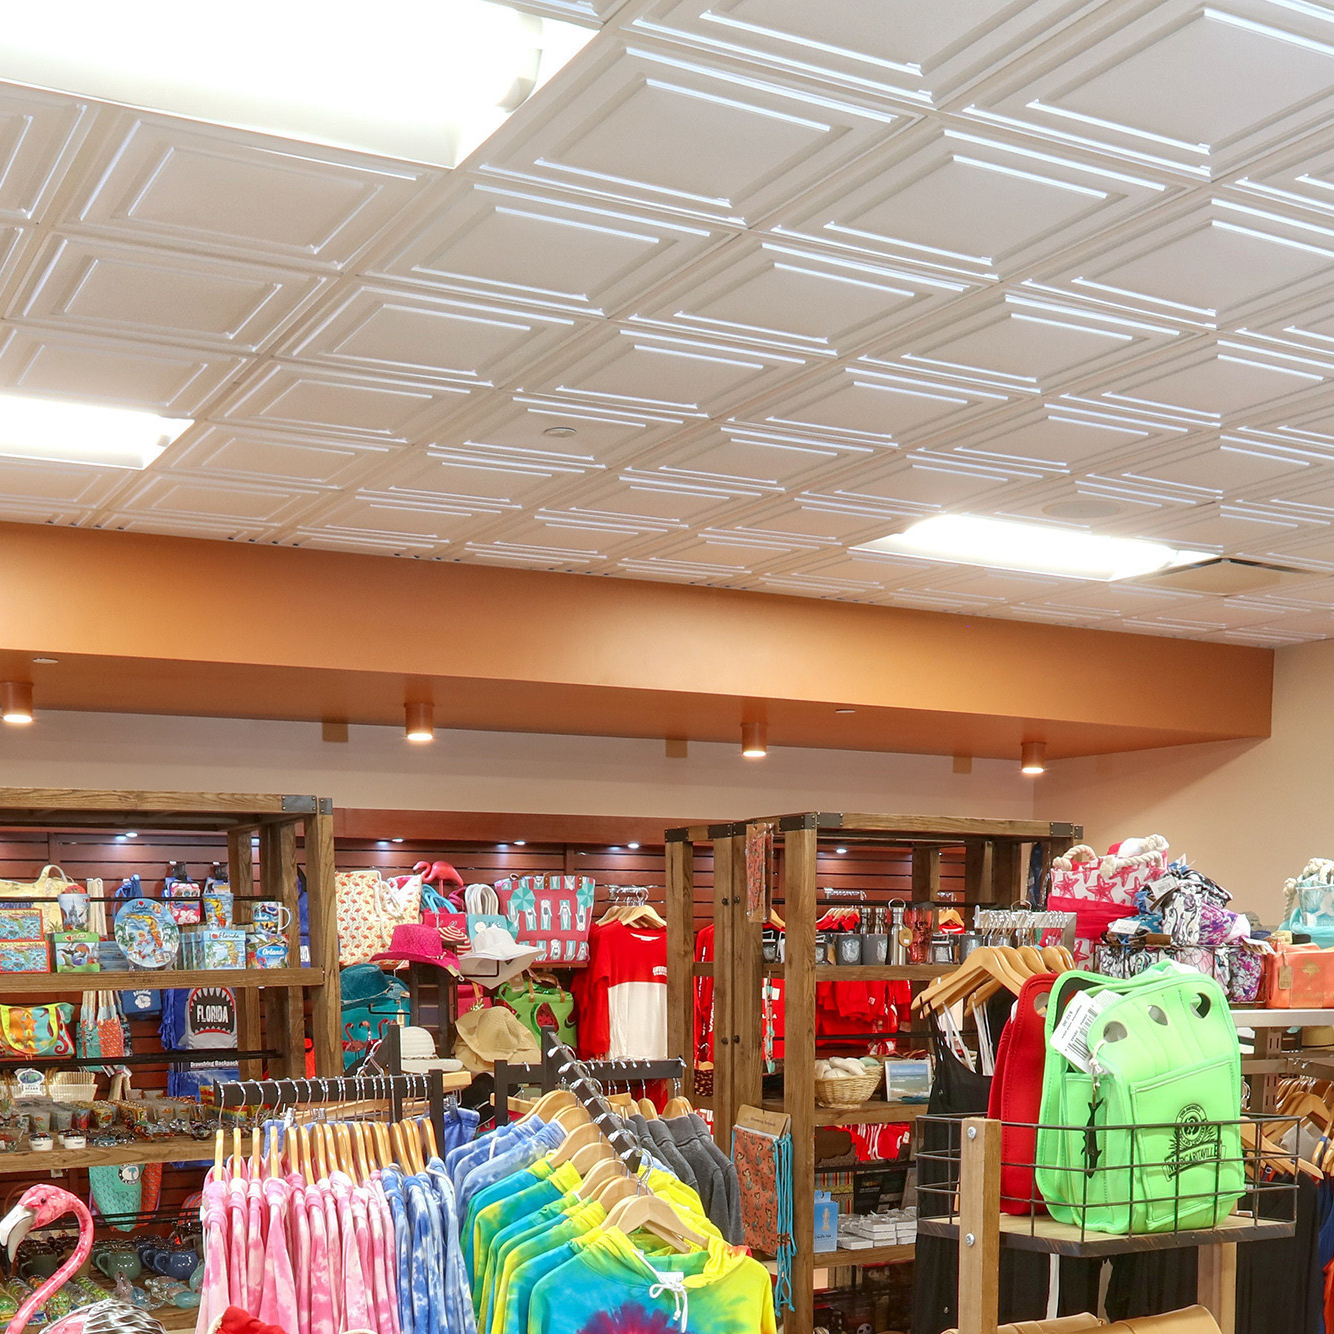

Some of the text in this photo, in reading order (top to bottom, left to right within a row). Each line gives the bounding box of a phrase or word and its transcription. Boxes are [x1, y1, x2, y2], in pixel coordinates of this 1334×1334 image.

[218, 932, 240, 940] Florida
[262, 948, 285, 956] Orlando
[196, 1005, 229, 1024] FLORIDA
[215, 1059, 239, 1067] Backpack
